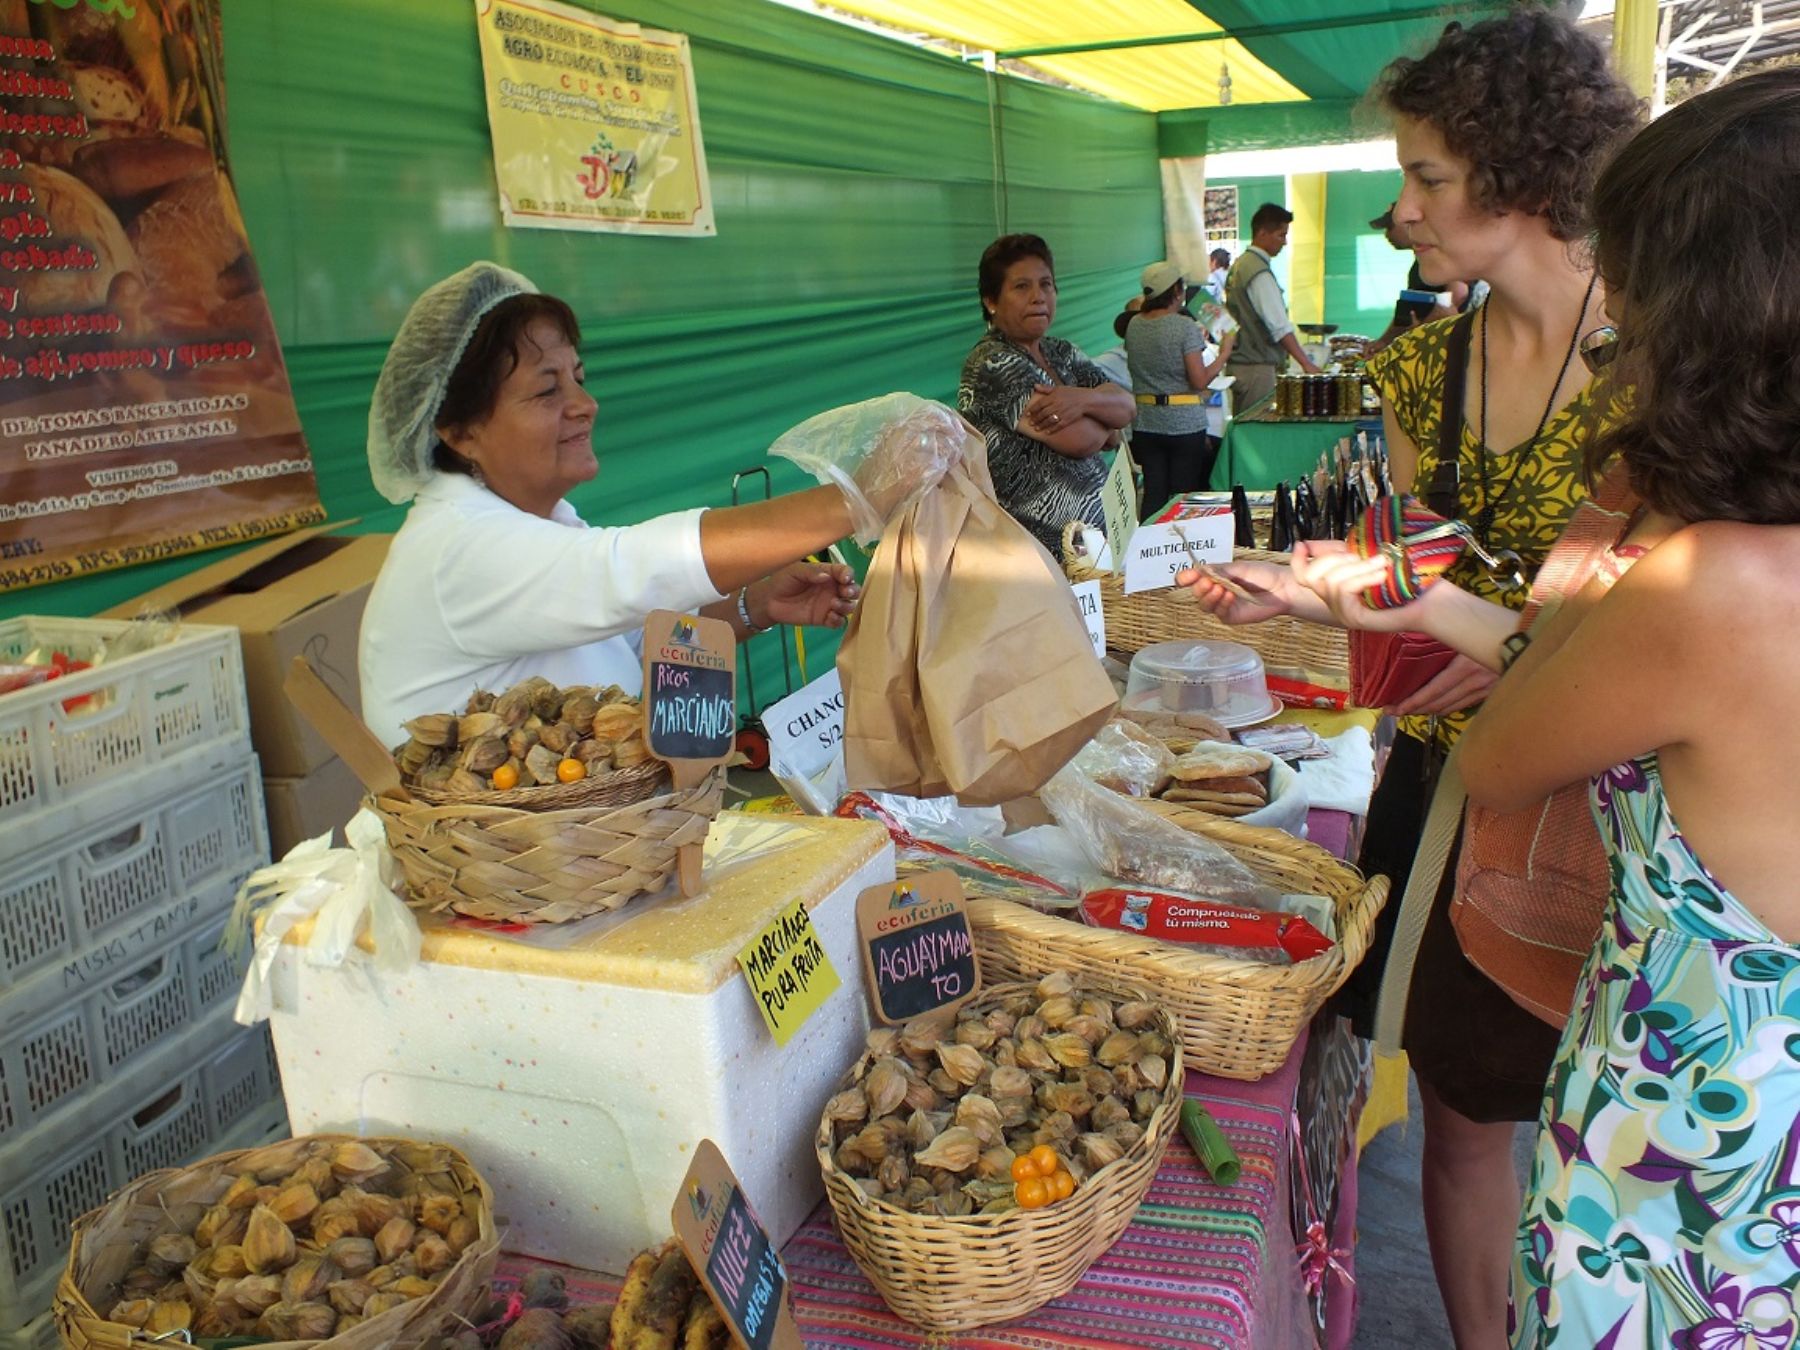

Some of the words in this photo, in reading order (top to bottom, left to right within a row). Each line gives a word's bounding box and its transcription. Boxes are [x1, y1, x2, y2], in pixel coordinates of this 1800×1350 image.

[176, 340, 255, 368] queso
[39, 407, 112, 432] TOMAS
[179, 393, 248, 416] RIOJAS
[25, 430, 133, 461] PANADERO
[135, 419, 236, 446] ARTESANAL
[1139, 538, 1216, 559] MULTICEREAL
[660, 647, 726, 669] ecoferia
[651, 693, 736, 741] MARCIANOS
[877, 898, 955, 933] ecoferia
[746, 902, 810, 993] MARCIANOS
[791, 936, 825, 993] FRUTA
[931, 972, 961, 1001] TO
